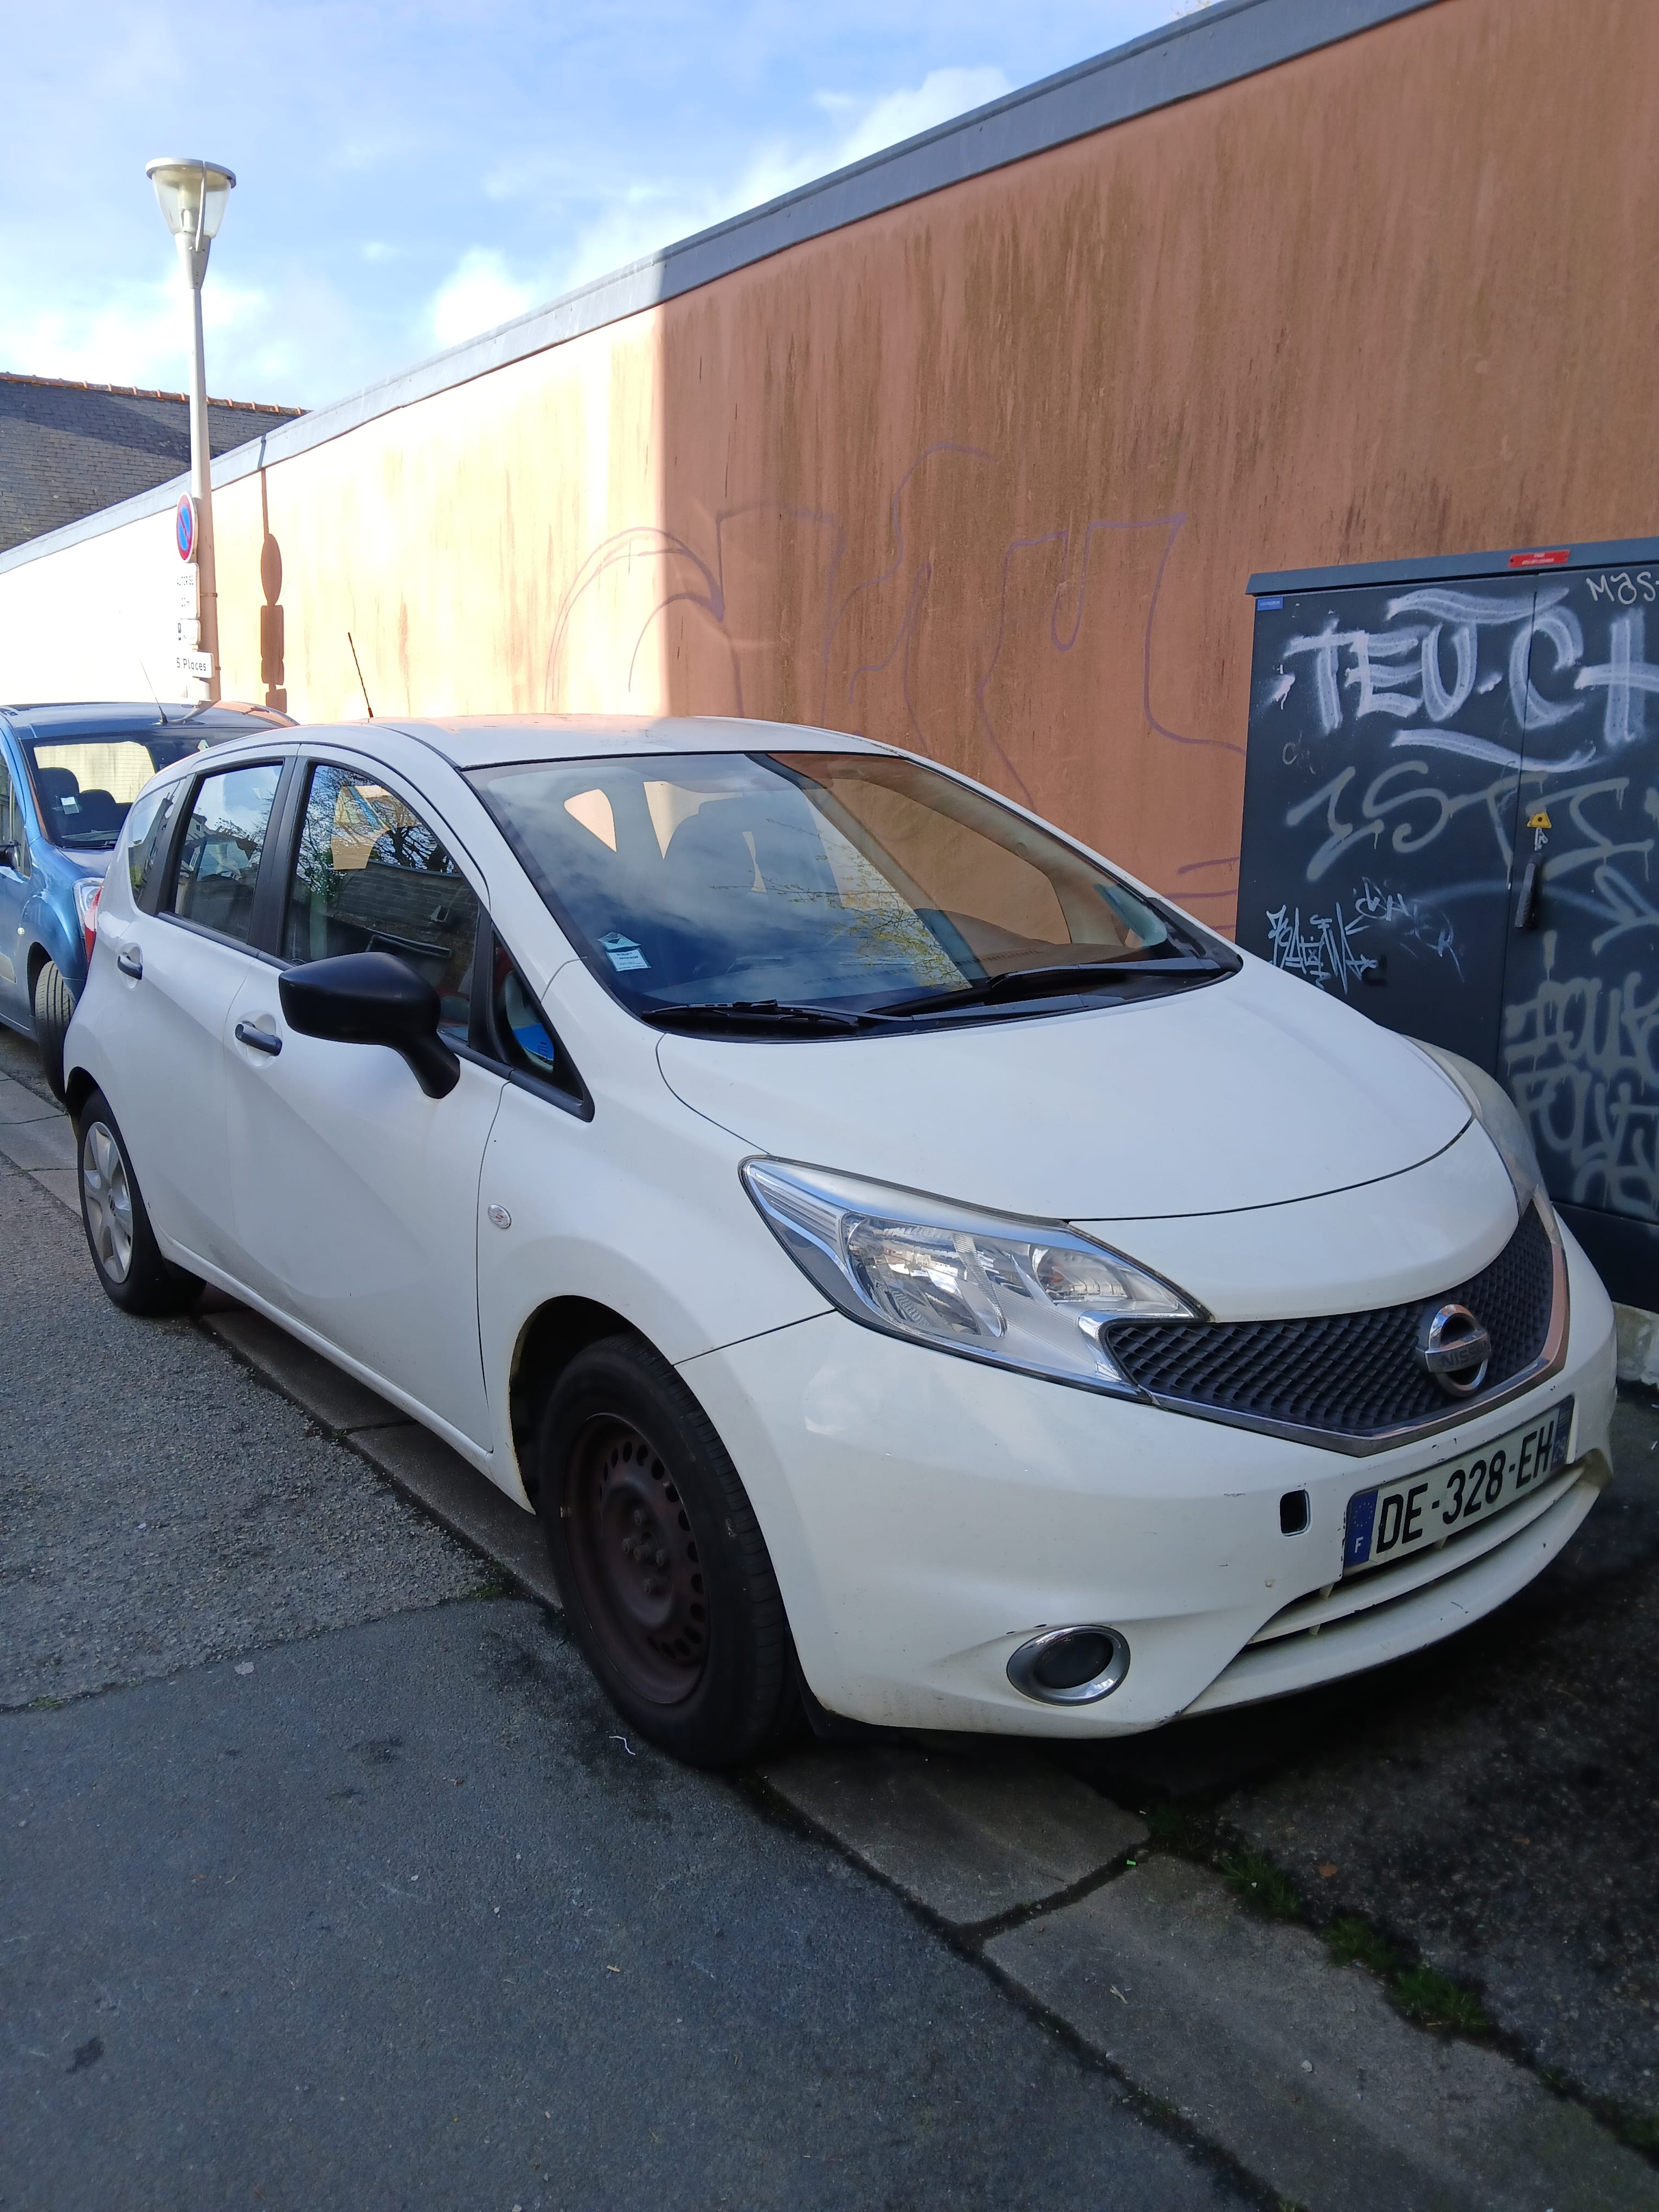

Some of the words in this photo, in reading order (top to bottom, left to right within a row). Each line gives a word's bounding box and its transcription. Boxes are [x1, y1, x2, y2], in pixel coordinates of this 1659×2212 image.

[176, 657, 181, 668] 5
[183, 658, 207, 671] Places
[1354, 1536, 1364, 1553] F
[1376, 1419, 1554, 1554] DE-328-EH
